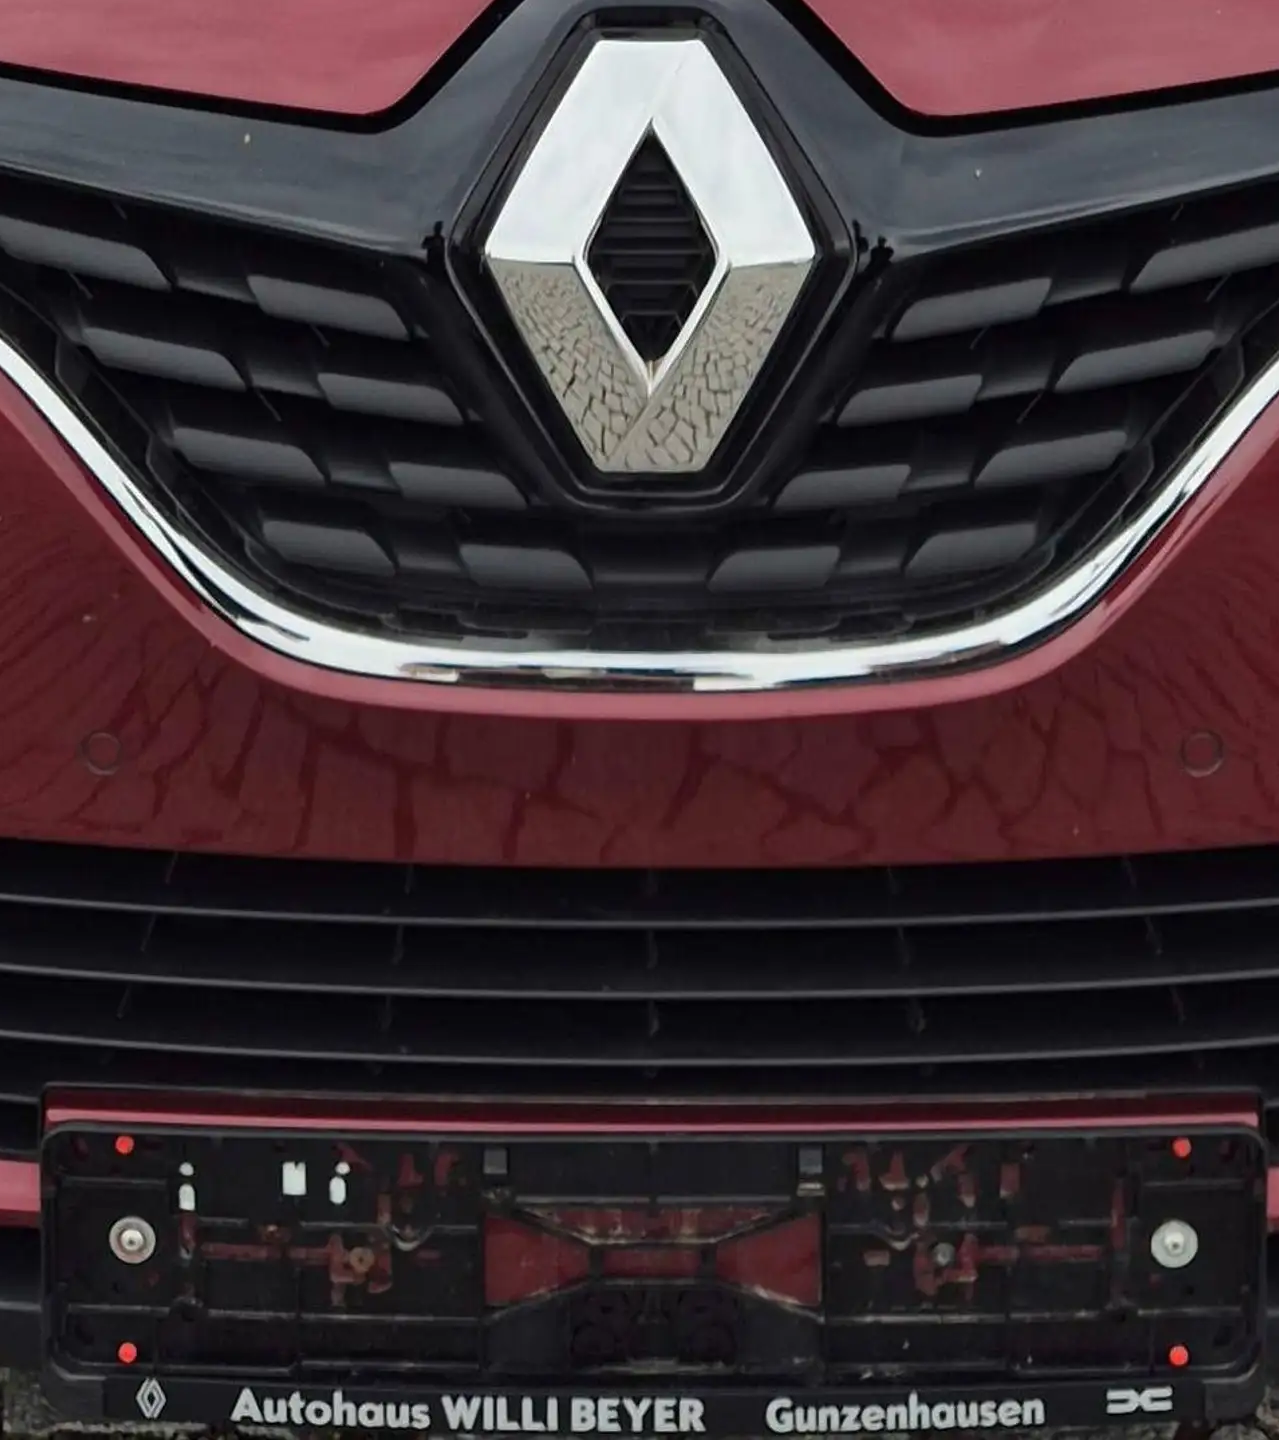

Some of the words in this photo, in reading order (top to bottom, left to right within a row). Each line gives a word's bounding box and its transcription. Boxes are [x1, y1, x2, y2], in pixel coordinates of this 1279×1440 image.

[230, 1387, 431, 1429] Autohaus
[441, 1395, 559, 1431] WILLI
[571, 1397, 706, 1432] BEYER
[766, 1389, 1045, 1433] Gunzenhausen
